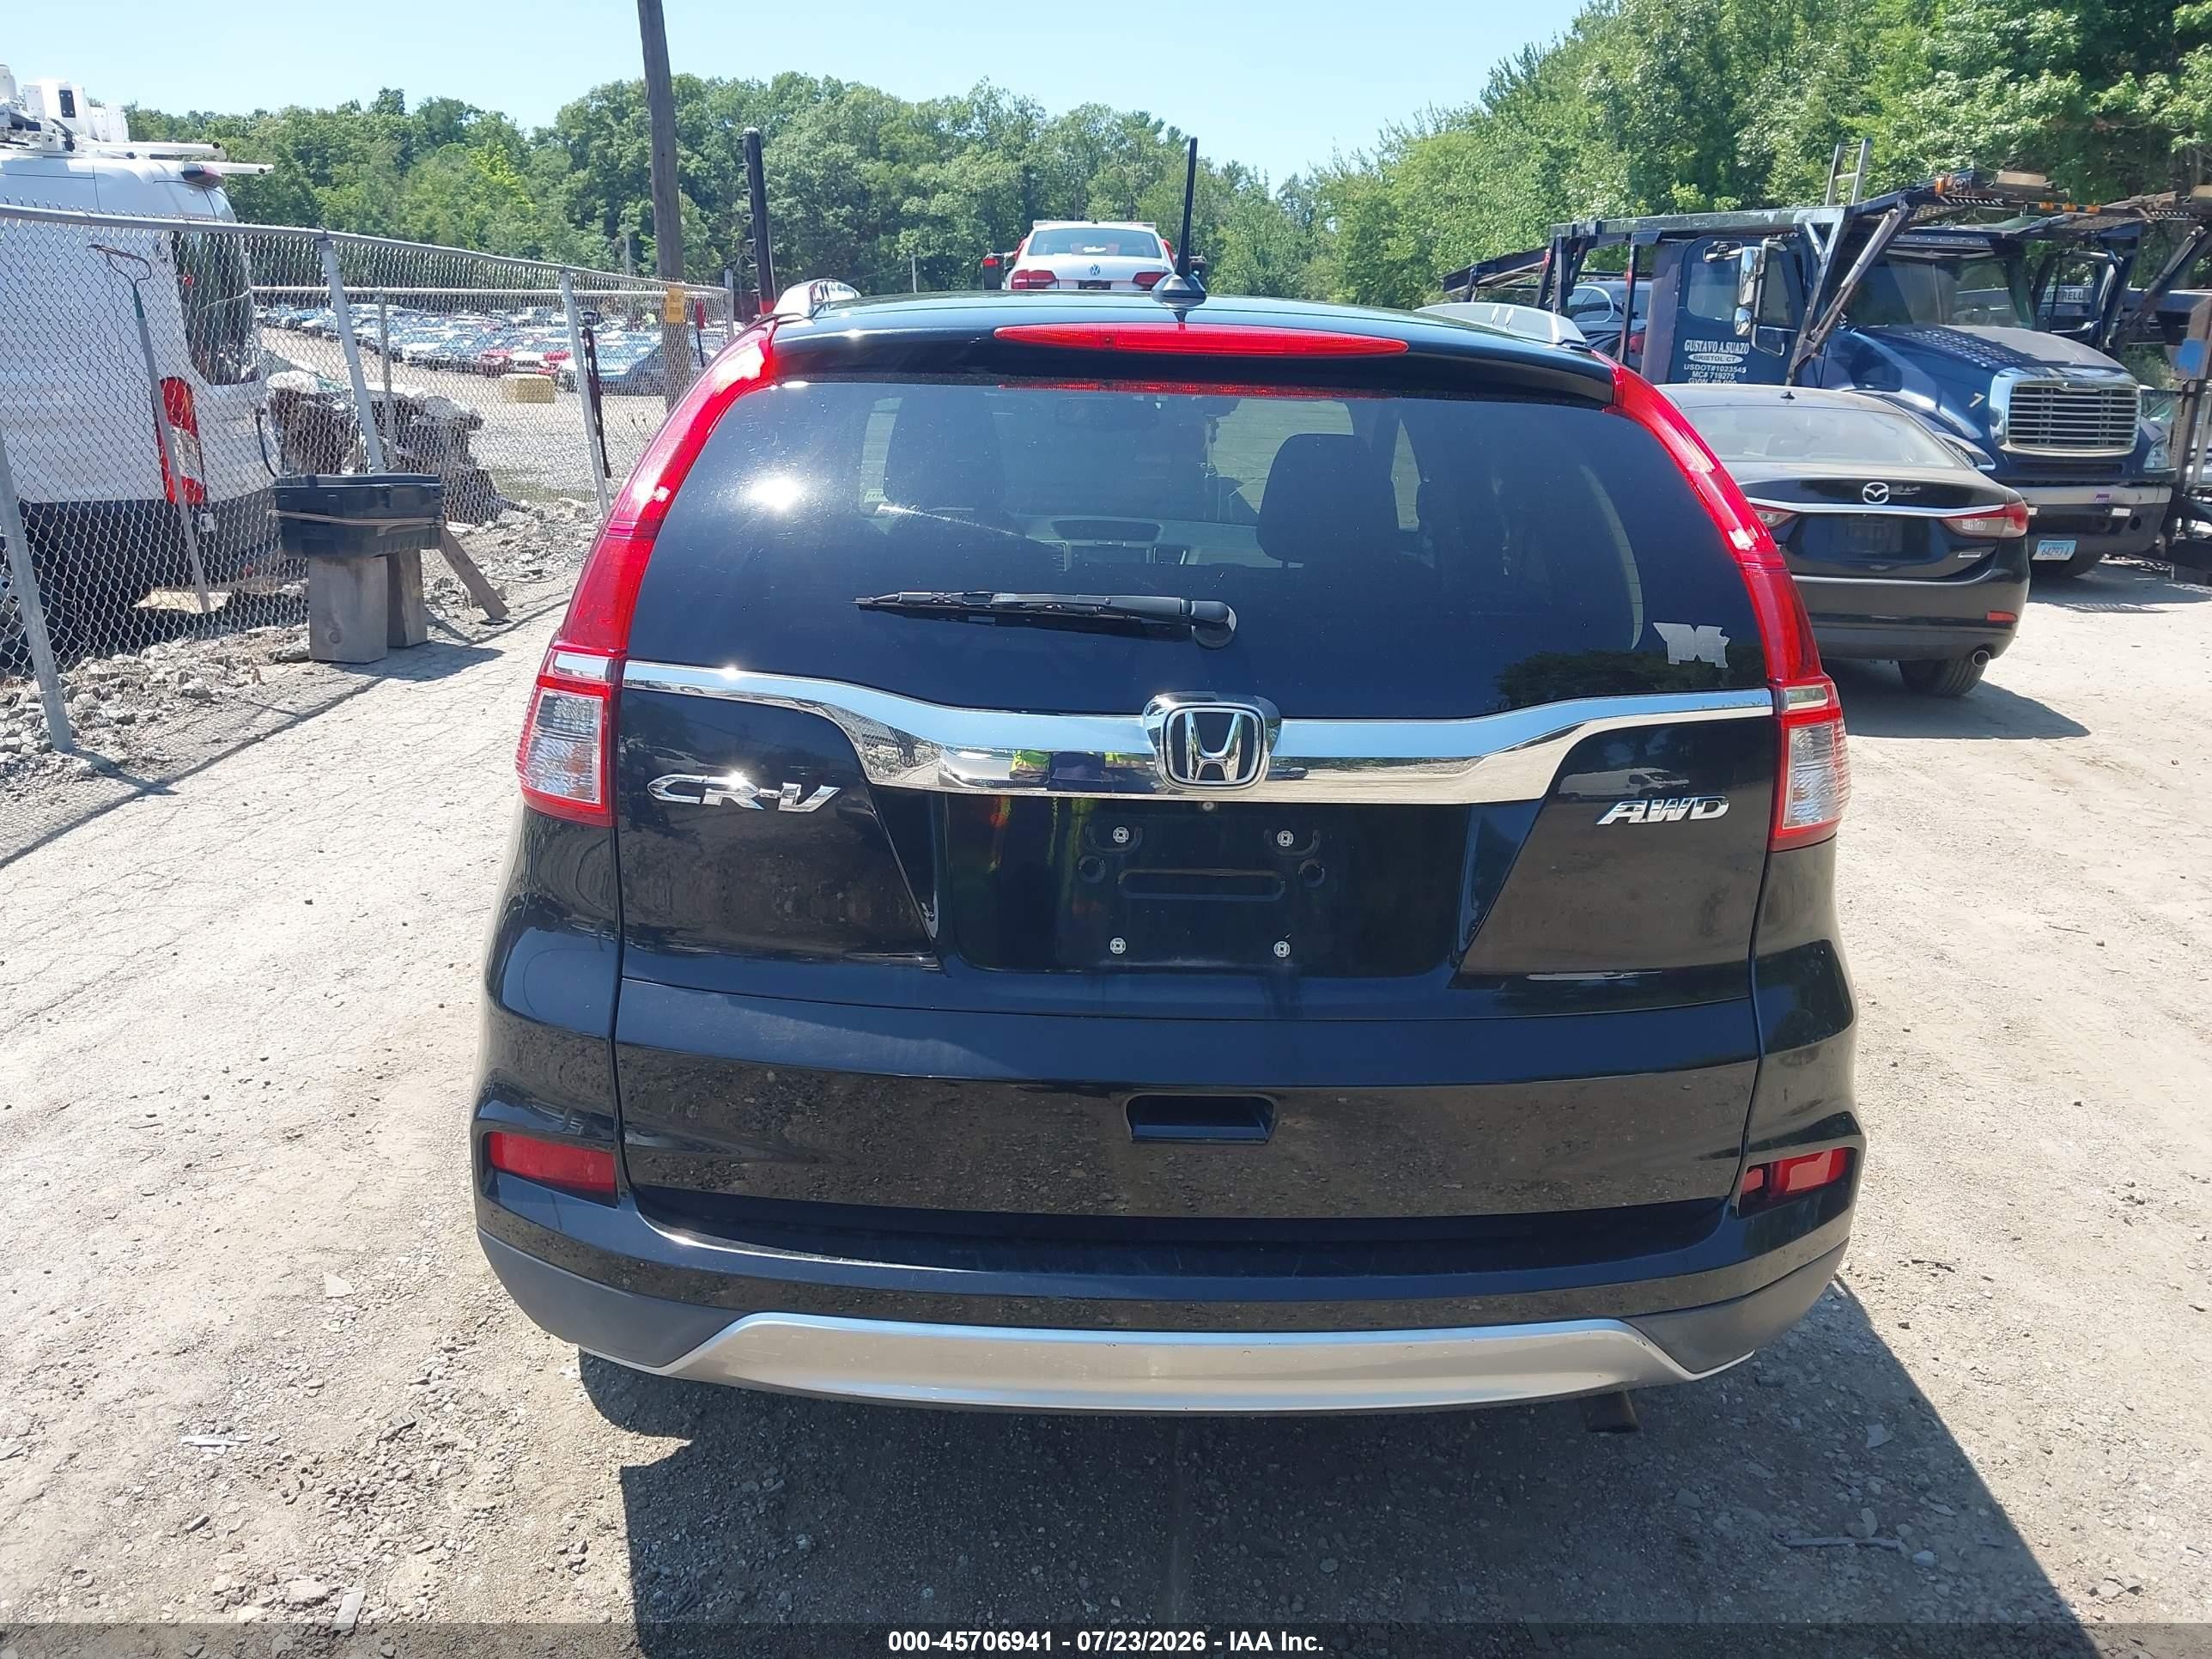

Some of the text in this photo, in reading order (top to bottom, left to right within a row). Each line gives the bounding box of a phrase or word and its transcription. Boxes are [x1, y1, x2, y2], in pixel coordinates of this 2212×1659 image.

[1684, 339, 1718, 352] GUSTAVO
[647, 772, 842, 812] CR-V
[1596, 796, 1729, 825] AWD
